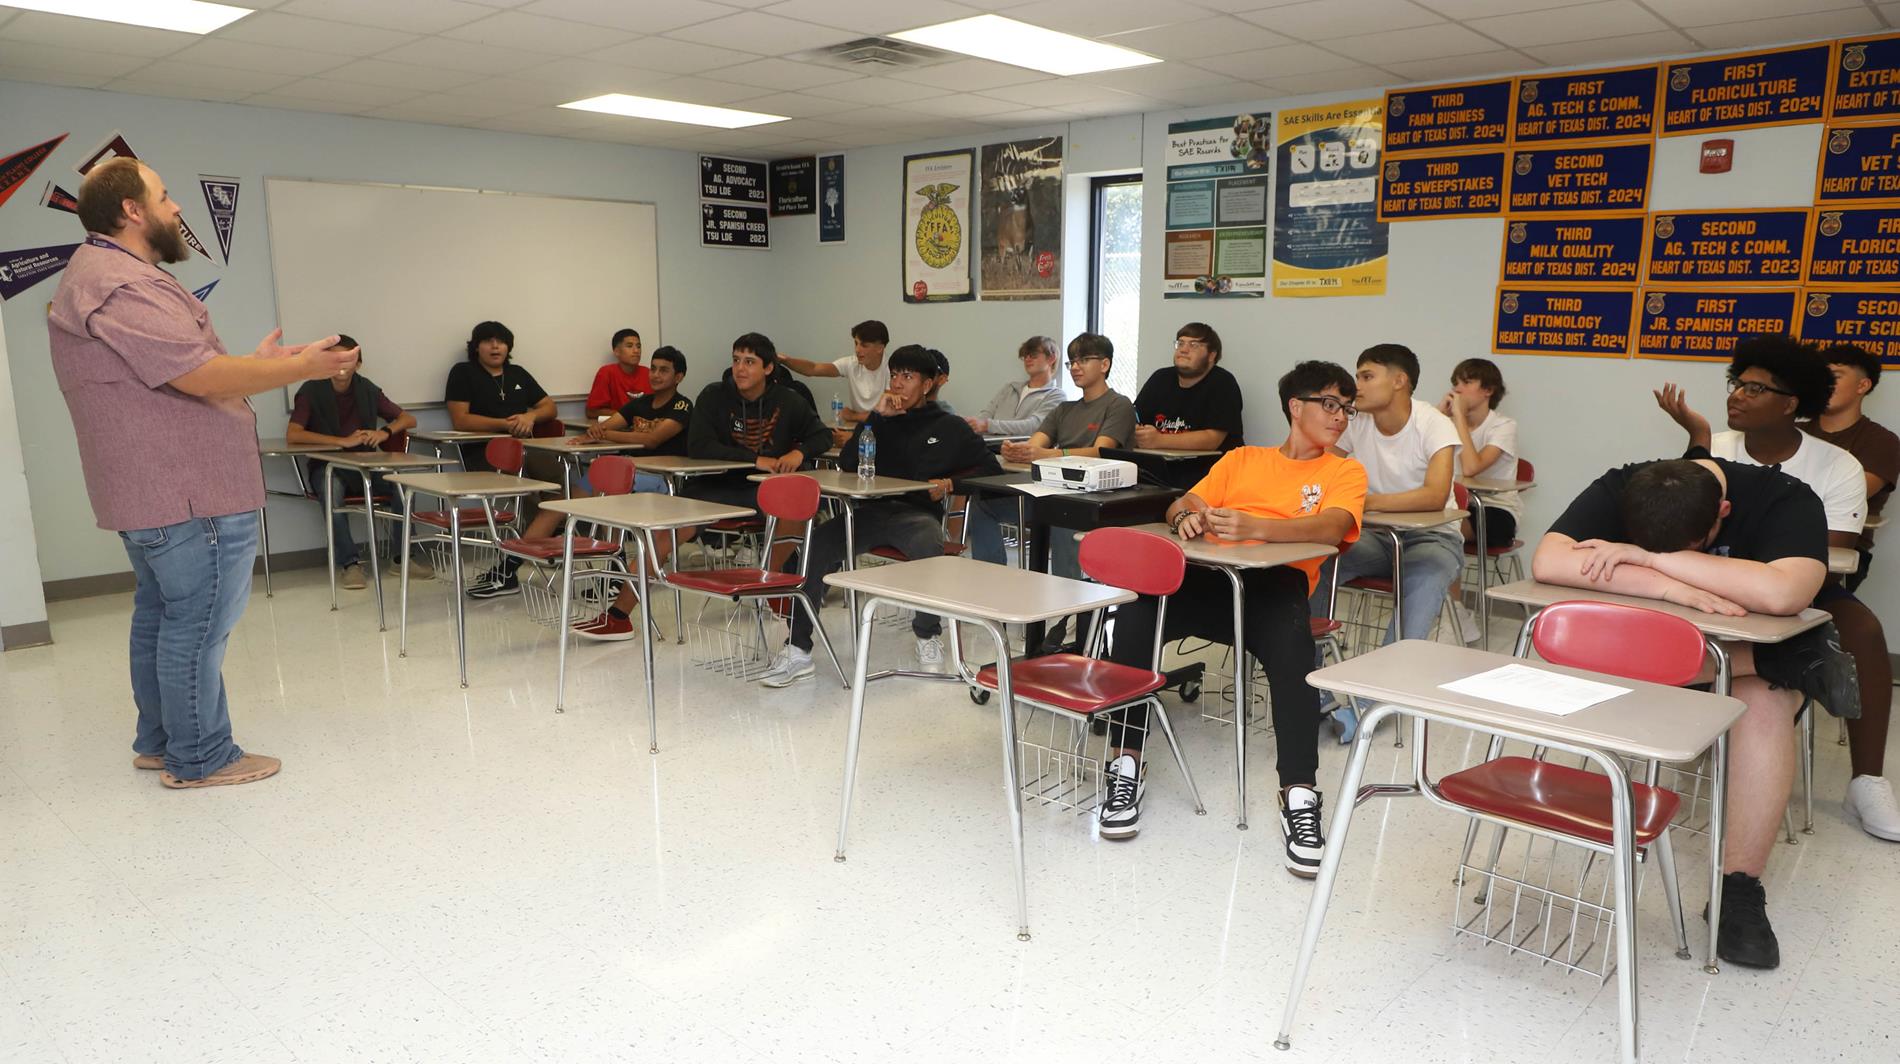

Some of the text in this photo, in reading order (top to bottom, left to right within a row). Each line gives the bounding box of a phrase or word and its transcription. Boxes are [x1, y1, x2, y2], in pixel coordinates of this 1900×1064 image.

[1723, 62, 1767, 81] FIRST
[1567, 81, 1604, 96] FIRST
[1691, 78, 1797, 104] FLORICULTURE
[1431, 93, 1464, 108] THIRD
[1527, 96, 1642, 118] AG. TECH & COMM.
[1836, 91, 1872, 110] HEART
[1873, 90, 1888, 107] OF
[1284, 116, 1299, 125] SAE
[1301, 113, 1324, 123] Skills
[1326, 111, 1341, 120] Are
[1408, 108, 1485, 127] FARM BUSINESS
[1667, 95, 1821, 125] HEART OF TEXAS DIST. 2024
[1517, 113, 1650, 136] HEART OF TEXAS DIST. 2024
[1387, 124, 1505, 145] HEART OF TEXAS DIST. 2024
[1172, 140, 1187, 148] Best
[1189, 138, 1216, 147] Practices
[1178, 146, 1221, 156] SAE Records
[723, 163, 747, 174] SECOND
[1426, 162, 1459, 177] THIRD
[1554, 154, 1604, 170] SECOND
[1861, 155, 1892, 172] VET
[713, 174, 756, 187] AG. ADVOCACY
[1390, 176, 1494, 195] CDE SWEEPSTAKES
[1548, 172, 1608, 188] VET TECH
[1823, 176, 1858, 192] HEART
[1860, 176, 1873, 191] OF
[704, 184, 718, 194] TSU
[719, 186, 732, 196] LDE
[1512, 188, 1643, 207] HEART OF TEXAS DIST. 2024
[1383, 194, 1499, 212] HEART OF TEXAS DIST. 2024
[723, 209, 747, 220] SECOND
[706, 219, 765, 232] JR. SPANISH CREED
[931, 222, 947, 234] FFA
[1701, 220, 1757, 236] SECOND
[706, 231, 719, 240] TSU
[721, 232, 733, 242] LDE
[1556, 227, 1592, 241] THIRD
[1530, 244, 1615, 259] MILK QUALITY
[1664, 240, 1791, 256] AG. TECH & COMM.
[1506, 262, 1636, 276] HEART OF TEXAS DIST. 2024
[1651, 259, 1800, 275] HEART OF TEXAS DIST. 2023
[1812, 259, 1898, 275] HEART OF TEXAS
[1546, 298, 1582, 312] THIRD
[1696, 299, 1737, 313] FIRST
[1857, 300, 1900, 316] SECO
[1523, 315, 1602, 329] ENTOMOLOGY
[1650, 317, 1784, 333] JR. SPANISH CREED
[1835, 320, 1866, 335] VET
[1499, 331, 1627, 348] HEART OF TEXAS DIST. 2024
[1640, 335, 1668, 349] HEART
[1670, 335, 1683, 349] OF
[1685, 336, 1713, 350] TEXAS
